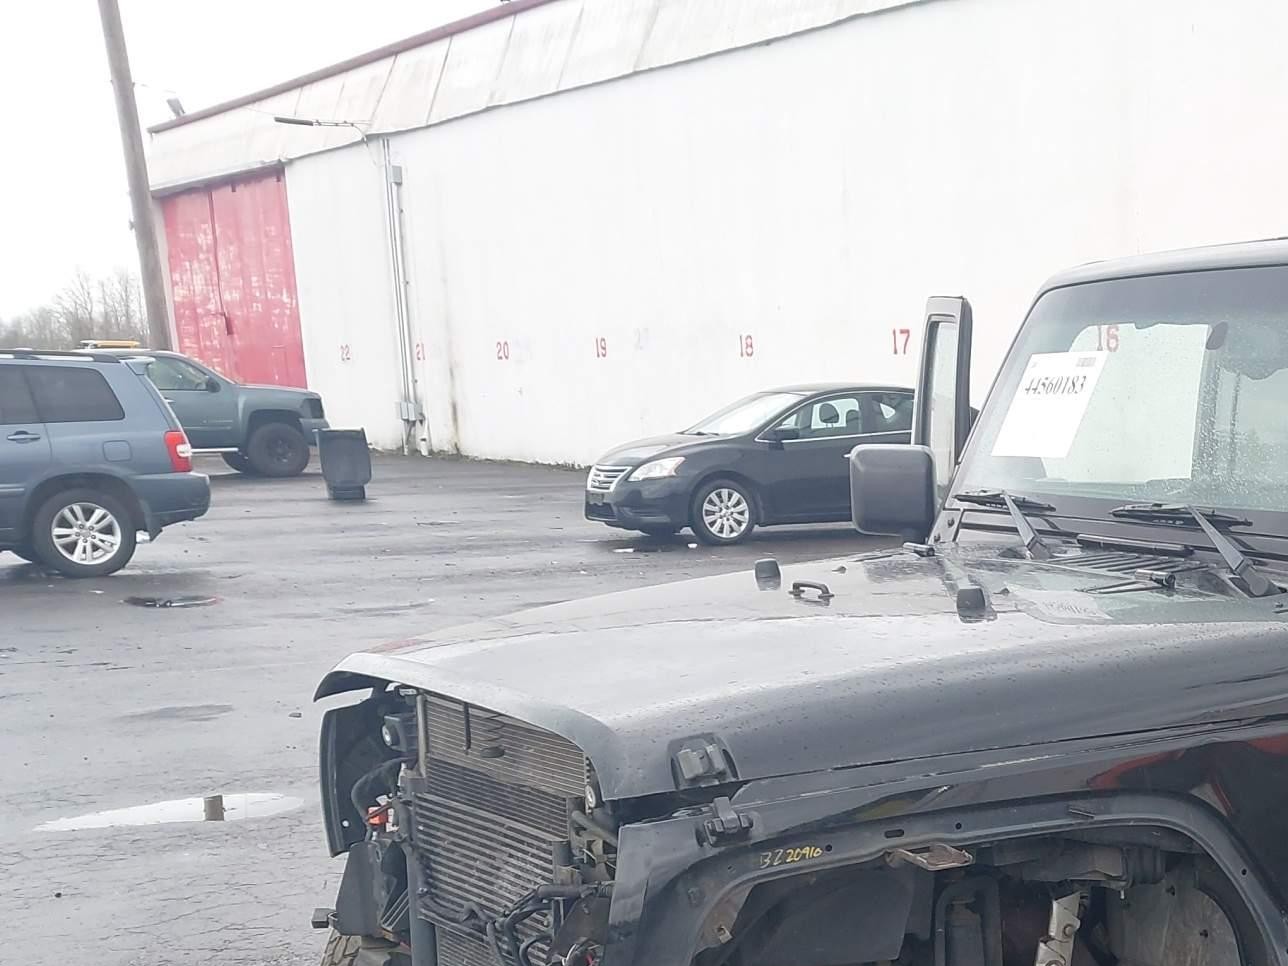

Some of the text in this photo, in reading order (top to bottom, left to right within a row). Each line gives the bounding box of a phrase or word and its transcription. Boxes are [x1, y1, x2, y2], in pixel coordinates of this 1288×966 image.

[595, 338, 607, 358] 19
[739, 334, 754, 357] 18
[892, 328, 910, 355] 17
[1096, 324, 1120, 352] 16
[496, 341, 509, 360] 20
[1025, 375, 1087, 394] 44560183
